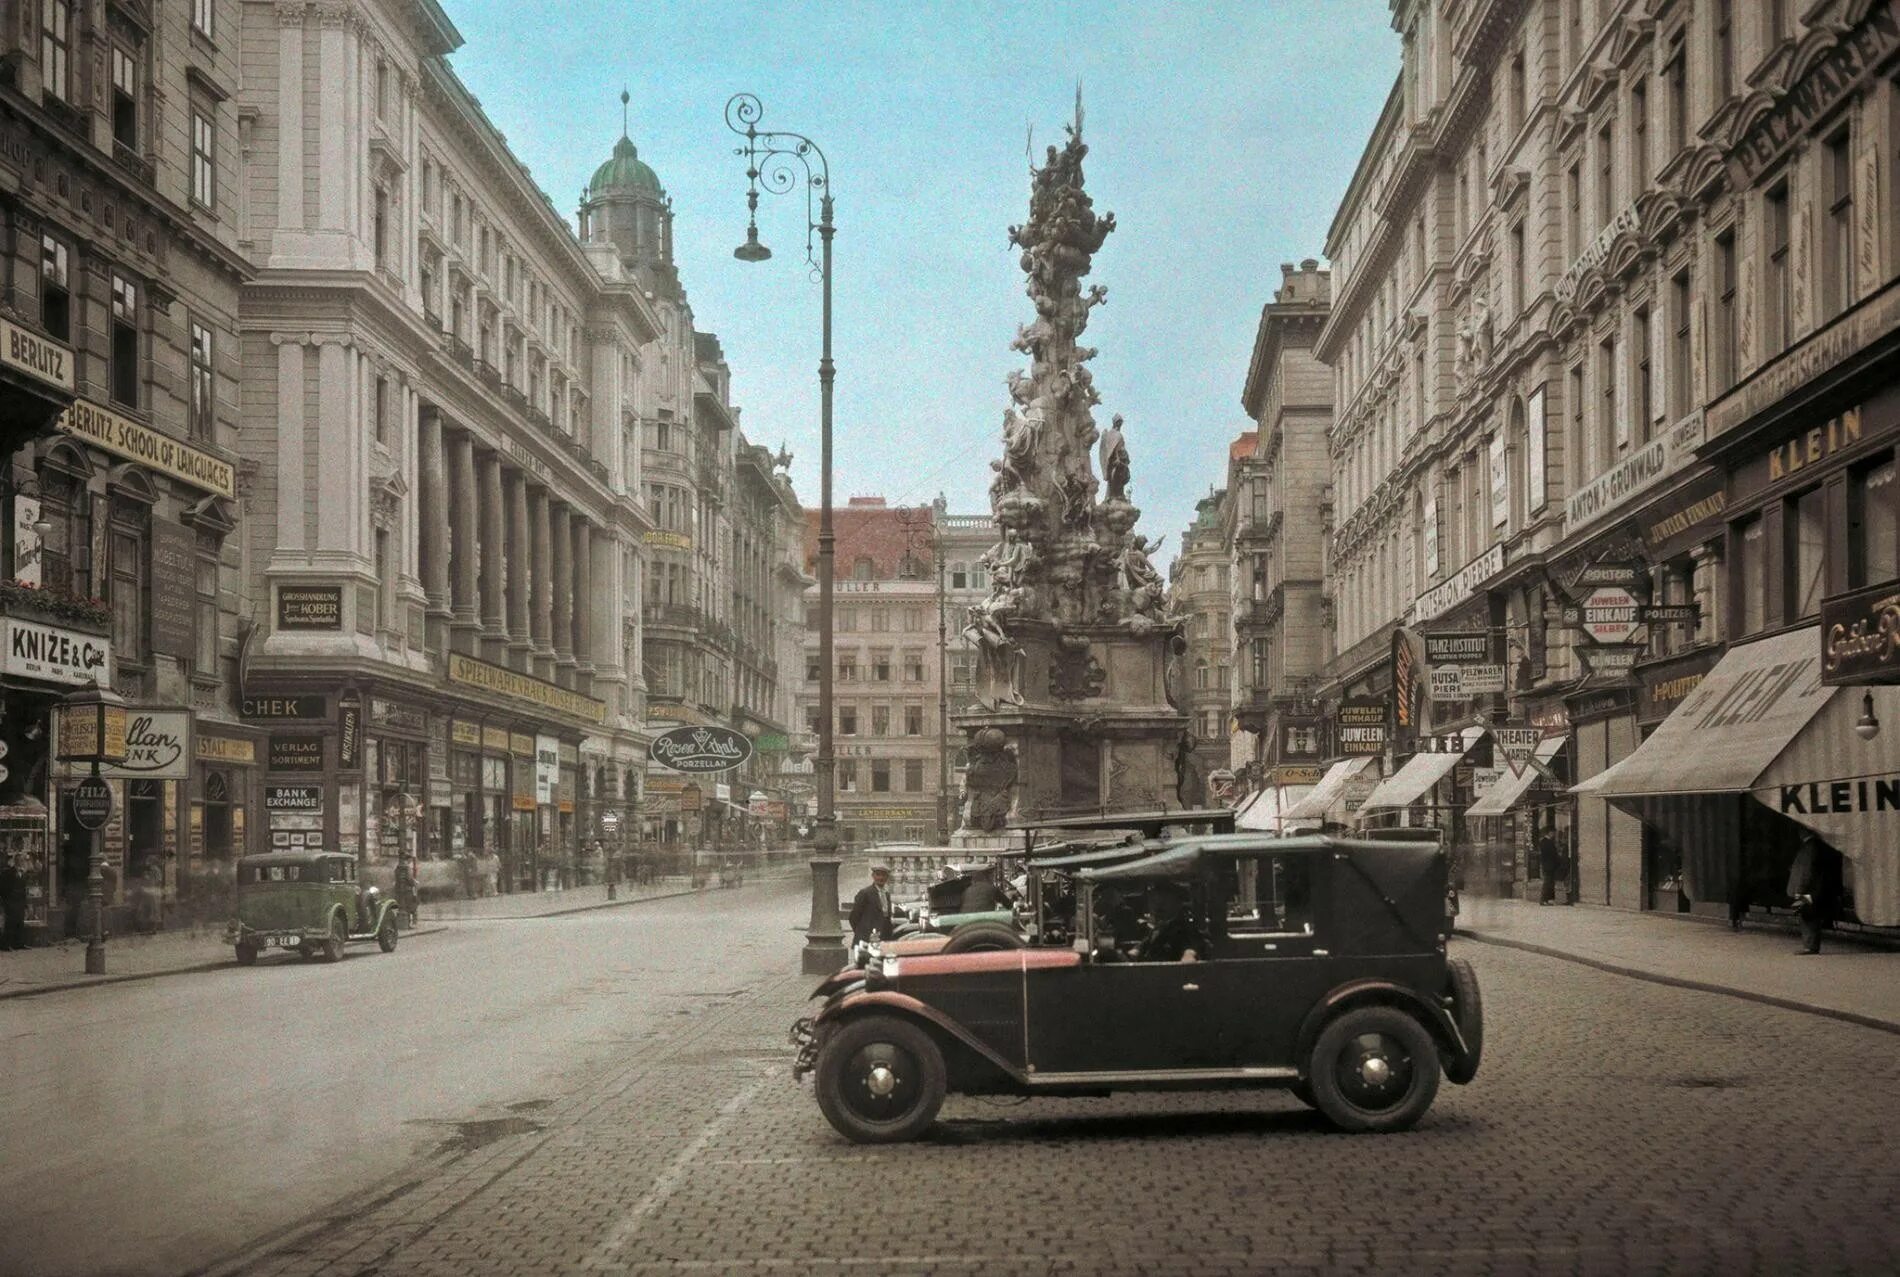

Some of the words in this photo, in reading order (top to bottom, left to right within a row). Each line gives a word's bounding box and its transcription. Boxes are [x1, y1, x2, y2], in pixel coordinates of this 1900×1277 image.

[1735, 3, 1900, 178] PELZWAREN
[10, 329, 64, 381] BERLITZ
[67, 405, 113, 444] BERLITZ
[118, 424, 160, 464] SCHOOL
[161, 443, 175, 467] OF
[176, 448, 230, 491] LANGUAGES
[1768, 405, 1862, 482] KLEIN
[301, 603, 338, 615] KOBER
[1644, 608, 1693, 619] POLITZER
[1584, 608, 1637, 623] EINKAUF
[1592, 624, 1629, 633] SILBER
[72, 643, 81, 668] &
[1431, 671, 1459, 684] HUTSA
[1461, 666, 1503, 677] PELZWAREN
[1340, 706, 1384, 715] JUWELEN
[342, 711, 355, 762] MUSIKALIEN
[1340, 727, 1384, 742] JUWELEN
[1496, 730, 1540, 745] THEATER
[273, 743, 317, 752] VERLAG
[1344, 743, 1382, 752] EINKAUF
[271, 756, 321, 765] SORTIMENT
[676, 760, 727, 768] PORZELLAN
[80, 786, 108, 798] FILZ
[276, 788, 308, 798] BANK
[1781, 779, 1900, 814] KLEIN
[266, 798, 317, 807] EXCHANGE
